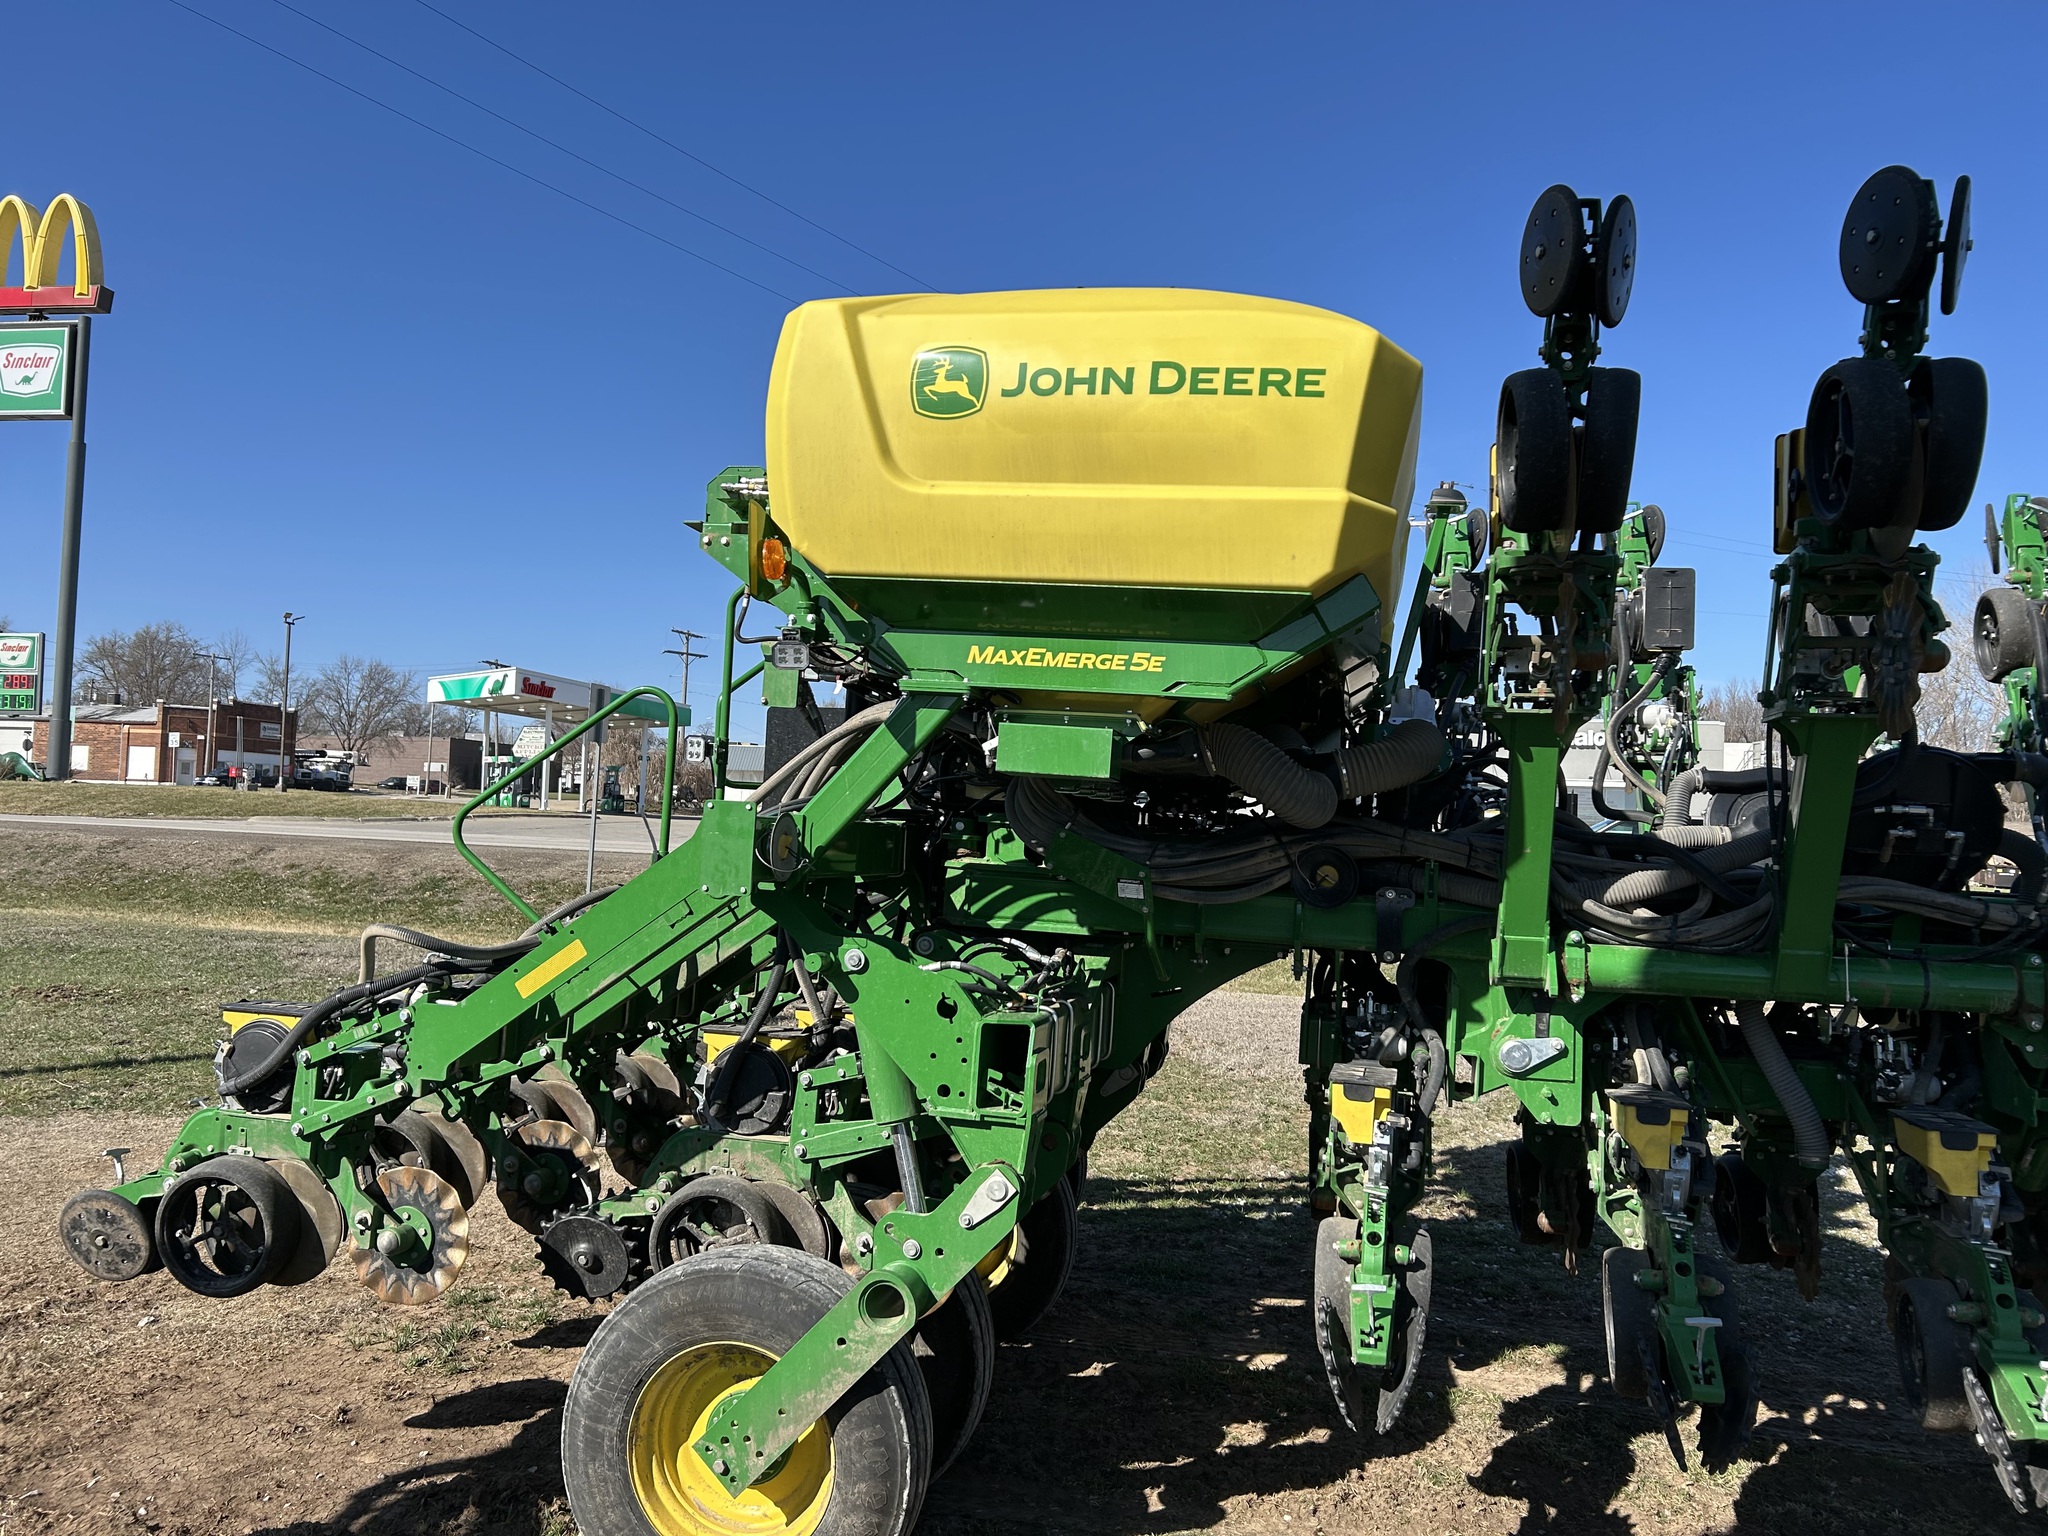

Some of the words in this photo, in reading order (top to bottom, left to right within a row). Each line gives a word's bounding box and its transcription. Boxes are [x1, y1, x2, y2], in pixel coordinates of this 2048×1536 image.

[2, 352, 55, 369] Sinclair
[1001, 362, 1135, 398] JOHN
[1149, 360, 1326, 398] DEERE
[1, 643, 29, 652] Sinclair
[521, 677, 556, 698] Sinclair
